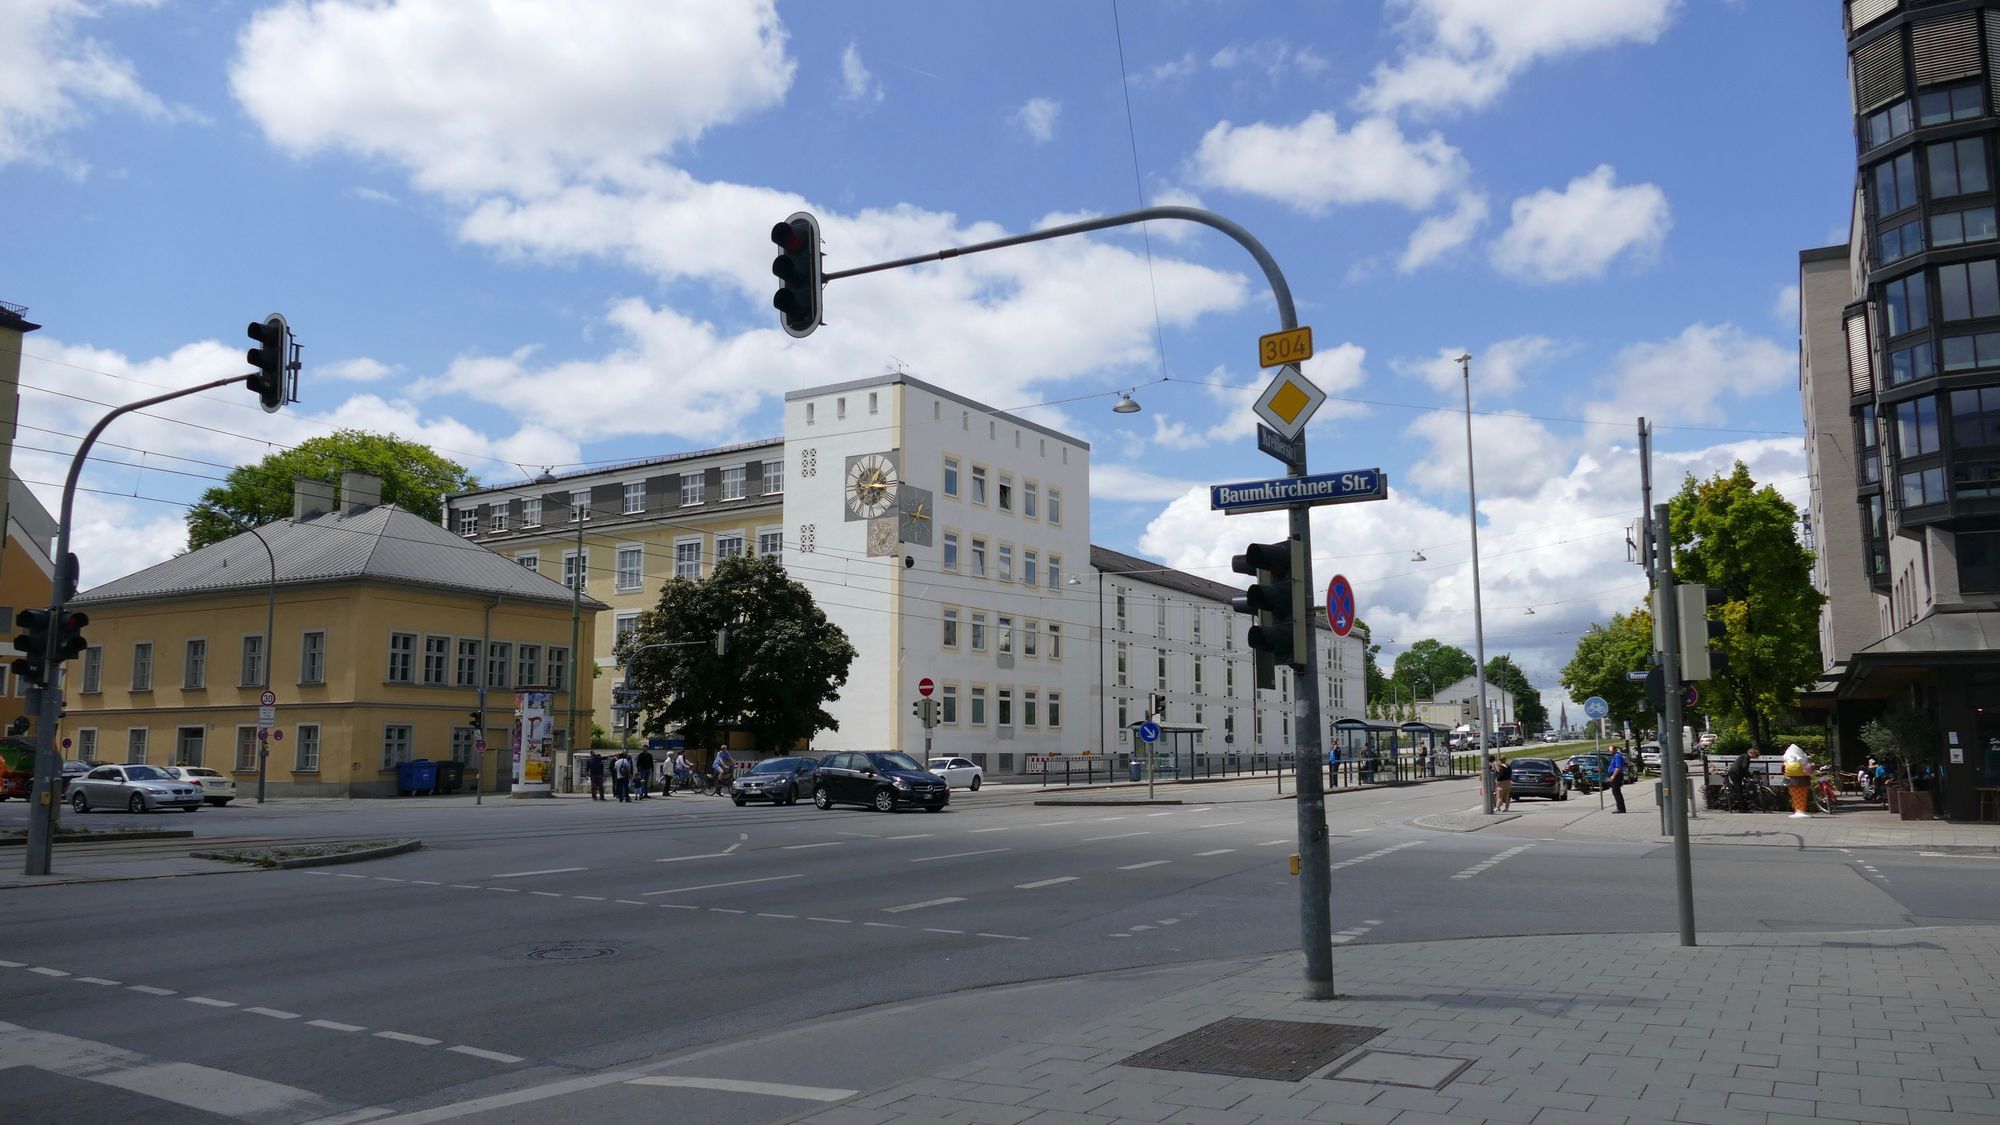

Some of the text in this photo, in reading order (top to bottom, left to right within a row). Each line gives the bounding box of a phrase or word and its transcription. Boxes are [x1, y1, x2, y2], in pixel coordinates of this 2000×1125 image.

[1266, 335, 1305, 361] 304
[1219, 474, 1372, 504] Baumkirchner Str.
[263, 694, 273, 703] 30
